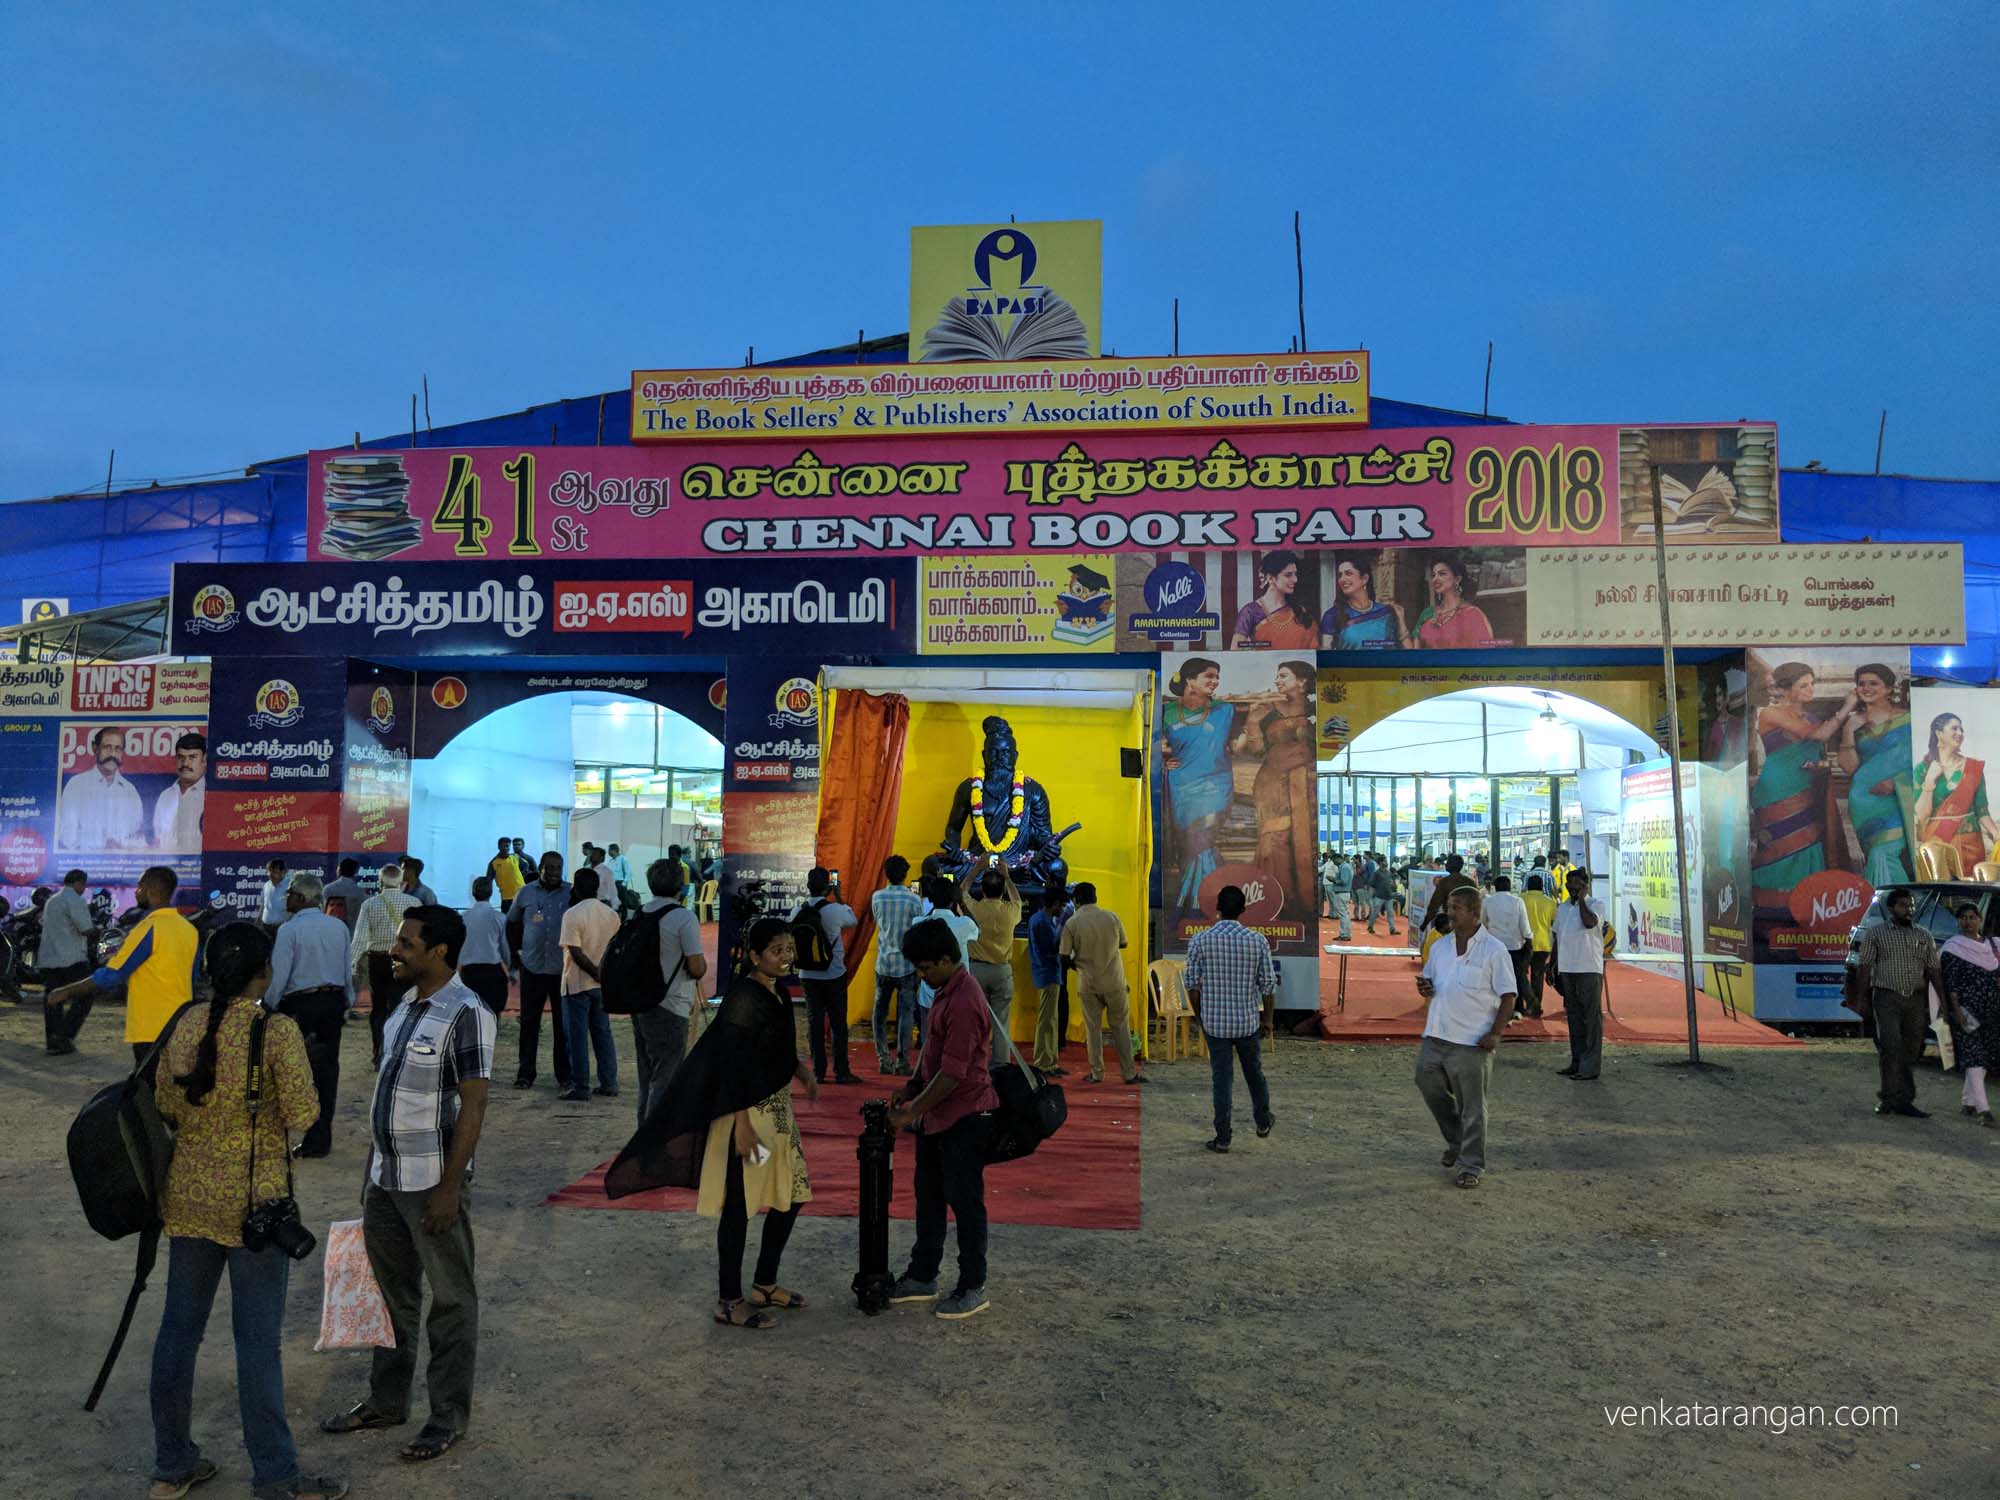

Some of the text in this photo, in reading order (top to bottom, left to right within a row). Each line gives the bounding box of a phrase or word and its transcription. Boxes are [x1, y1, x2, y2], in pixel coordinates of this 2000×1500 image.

[966, 298, 1045, 315] BAPASI
[642, 360, 1359, 405] தென்னிந்திய புத்தக விற்பனையாளர் மற்றும் பதிப்பாளர் சங்கம்
[643, 408, 687, 429] The
[696, 406, 755, 429] Book
[854, 406, 876, 427] &
[1023, 399, 1158, 421] Association
[1168, 395, 1193, 419] of
[1200, 394, 1272, 417] South
[1282, 393, 1356, 416] India.
[432, 438, 1607, 558] 41 ஆவது சென்னை புத்தகக்காட்சி 2018
[549, 505, 1433, 555] St CHENNAI BOOK FAIR
[927, 562, 1054, 588] பார்க்கலாம்...
[1803, 577, 1875, 591] பொங்கல்
[927, 590, 1055, 616] வாங்கலாம்...
[1156, 576, 1193, 612] Nalli
[1594, 585, 1638, 607] நல்லி
[1738, 583, 1789, 607] செட்டி
[1803, 594, 1895, 611] வாழ்த்துகள்!
[206, 599, 223, 615] IAS
[246, 575, 887, 639] ஆட்சித்தமிழ் ஐ.ஏ.எஸ் அகாடெமி
[927, 617, 1045, 646] படிக்கலாம்...
[1134, 617, 1216, 628] AMRUTHAVARSHINI
[0, 667, 64, 688] த்தமிழ்
[77, 666, 151, 694] TNPSC
[2, 692, 60, 708] அகாடெமி
[104, 693, 148, 708] POLICE
[270, 693, 287, 710] IAS
[791, 692, 808, 709] IAS
[216, 739, 334, 760] ஆட்சித்தமிழ்
[735, 739, 821, 760] ஆட்சித்த
[217, 763, 329, 778] ஐ.ஏ.எஸ் அகாடெமி
[736, 764, 789, 779] ஐ.ஏ.எஸ்
[1810, 887, 1862, 927] Nalli
